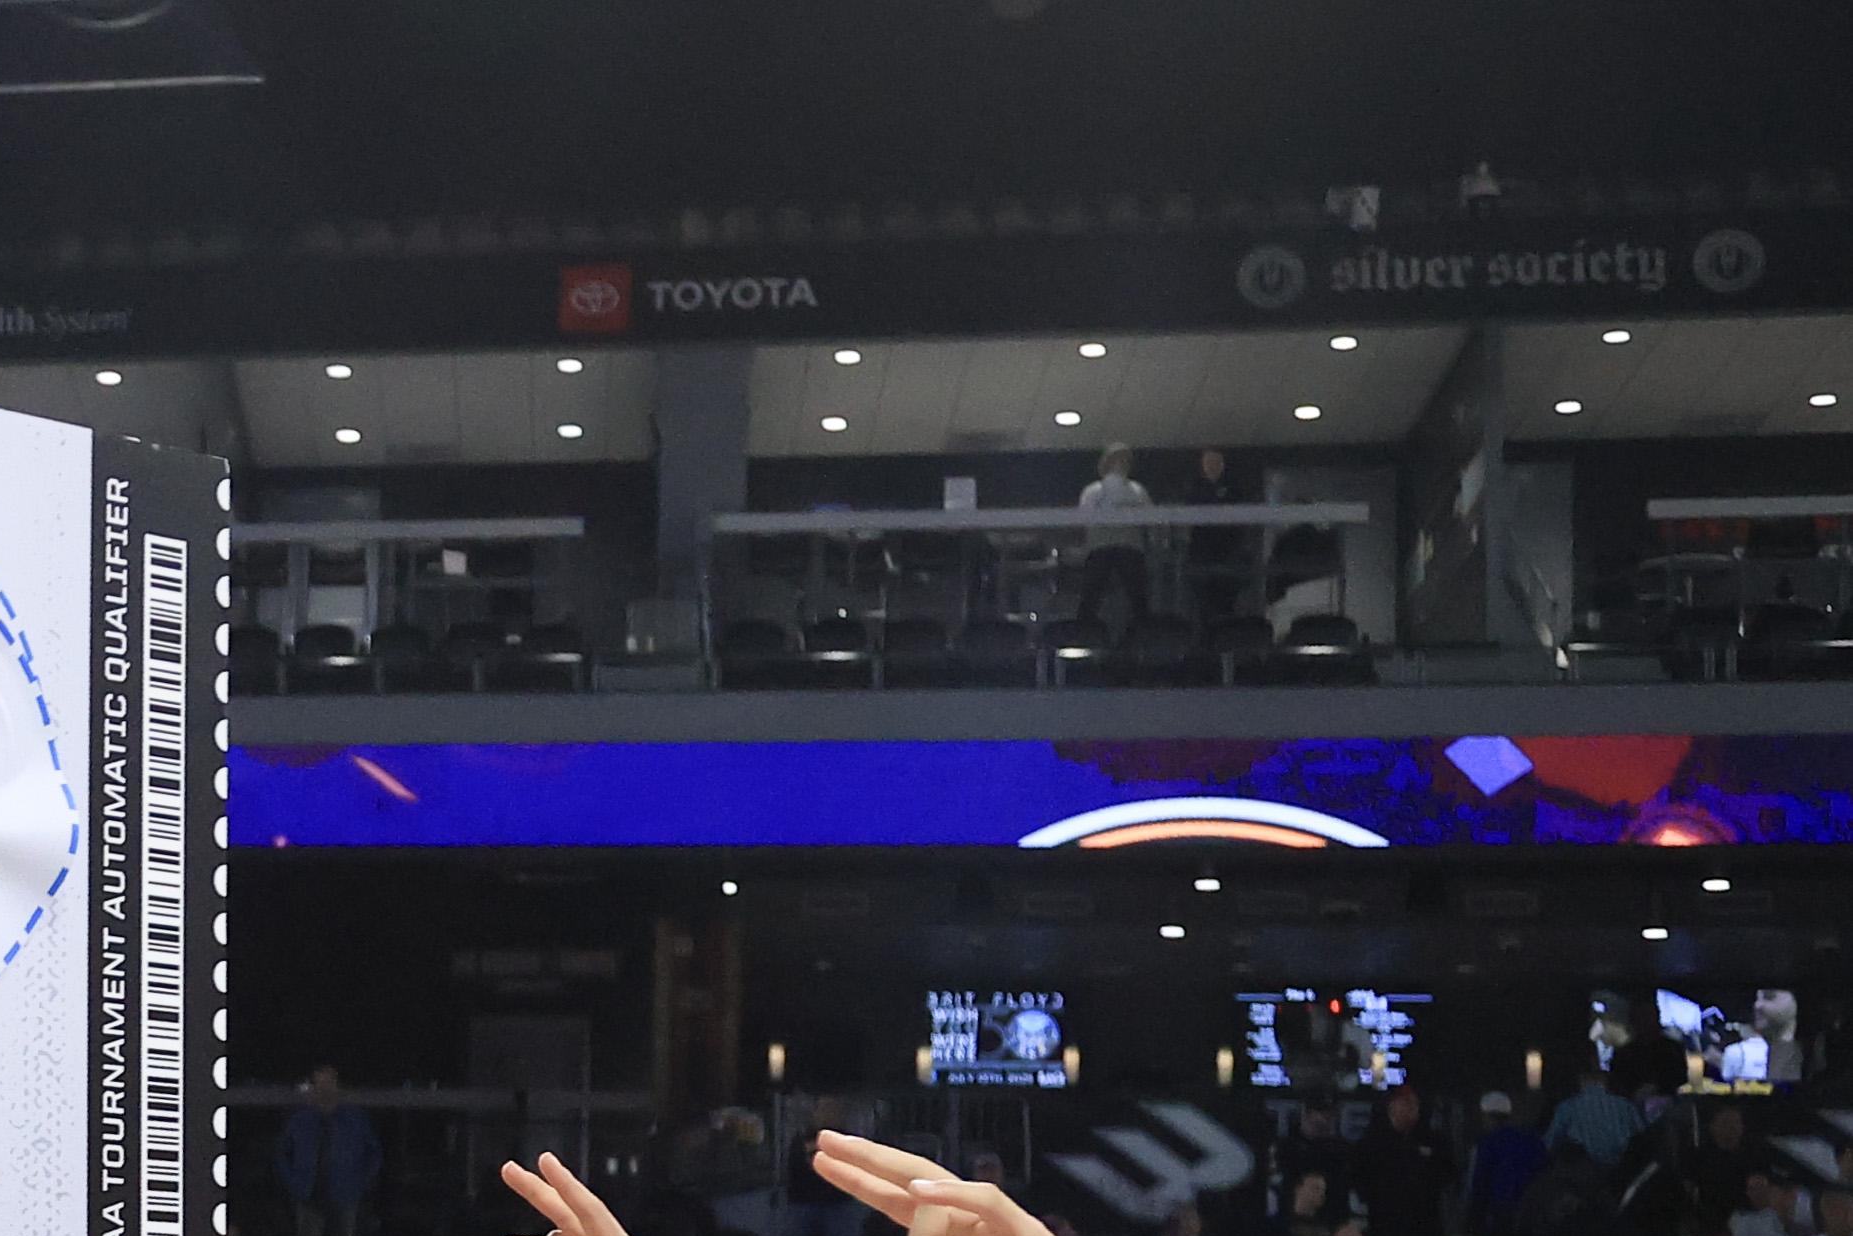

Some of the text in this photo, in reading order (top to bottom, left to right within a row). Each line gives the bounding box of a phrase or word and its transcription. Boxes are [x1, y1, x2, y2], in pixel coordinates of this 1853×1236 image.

[647, 276, 819, 312] TOYOTA
[1331, 238, 1668, 293] silver society
[102, 476, 131, 684] QUALIFIER
[101, 692, 129, 920] AUTOMATIC
[100, 926, 127, 1192] TOURNAMENT
